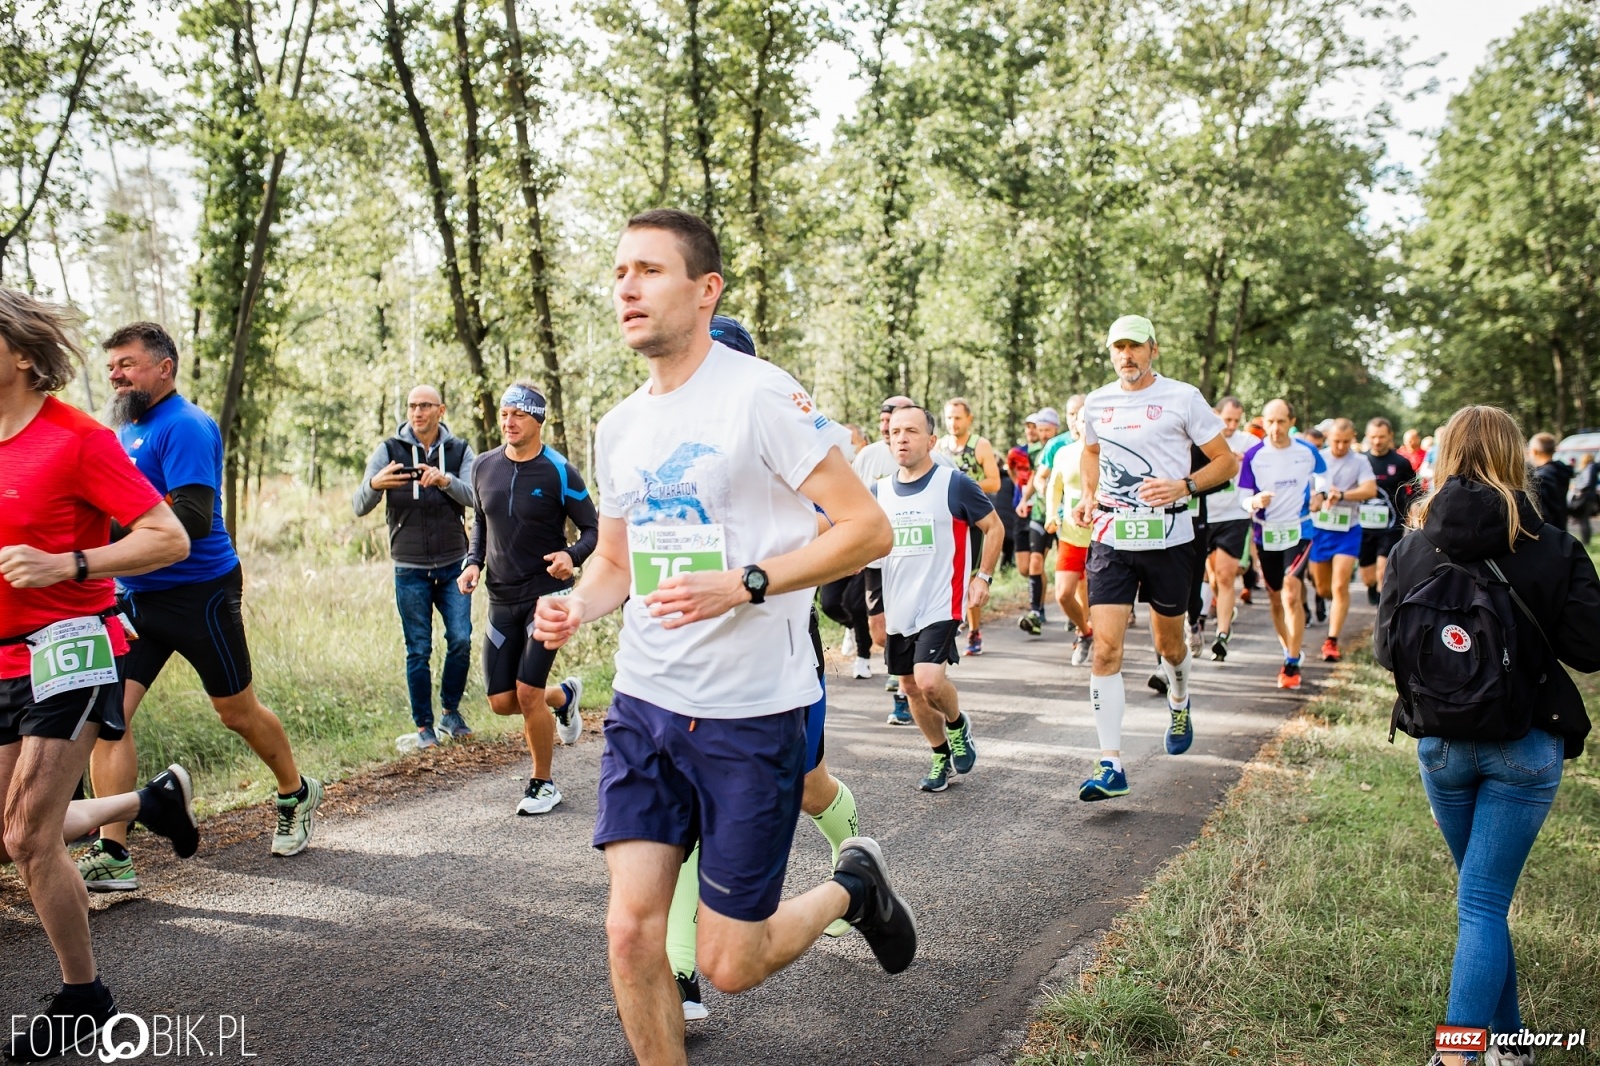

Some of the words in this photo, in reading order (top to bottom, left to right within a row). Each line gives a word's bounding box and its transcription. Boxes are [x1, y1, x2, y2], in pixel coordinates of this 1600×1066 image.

[659, 482, 698, 499] MARATON
[894, 527, 923, 546] 170
[1125, 521, 1149, 539] 93
[1272, 530, 1290, 544] 33
[43, 639, 95, 677] 167
